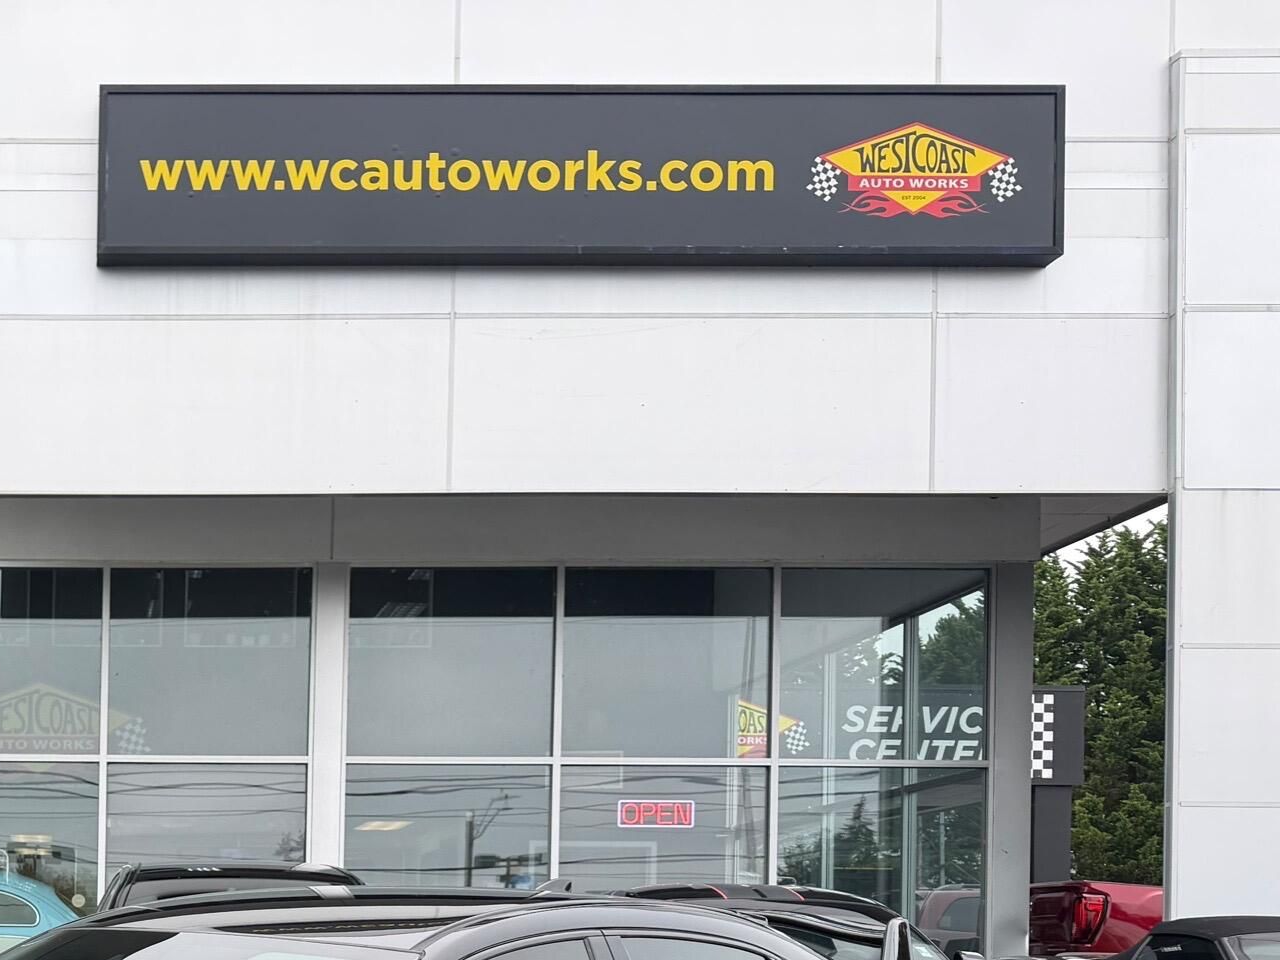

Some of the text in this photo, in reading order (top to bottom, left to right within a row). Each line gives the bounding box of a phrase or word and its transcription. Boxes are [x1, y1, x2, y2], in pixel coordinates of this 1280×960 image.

[140, 151, 776, 193] www.wcautoworks.com
[859, 178, 969, 189] AUTO WORKS
[33, 739, 96, 751] WORKS
[622, 803, 691, 825] OPEN
